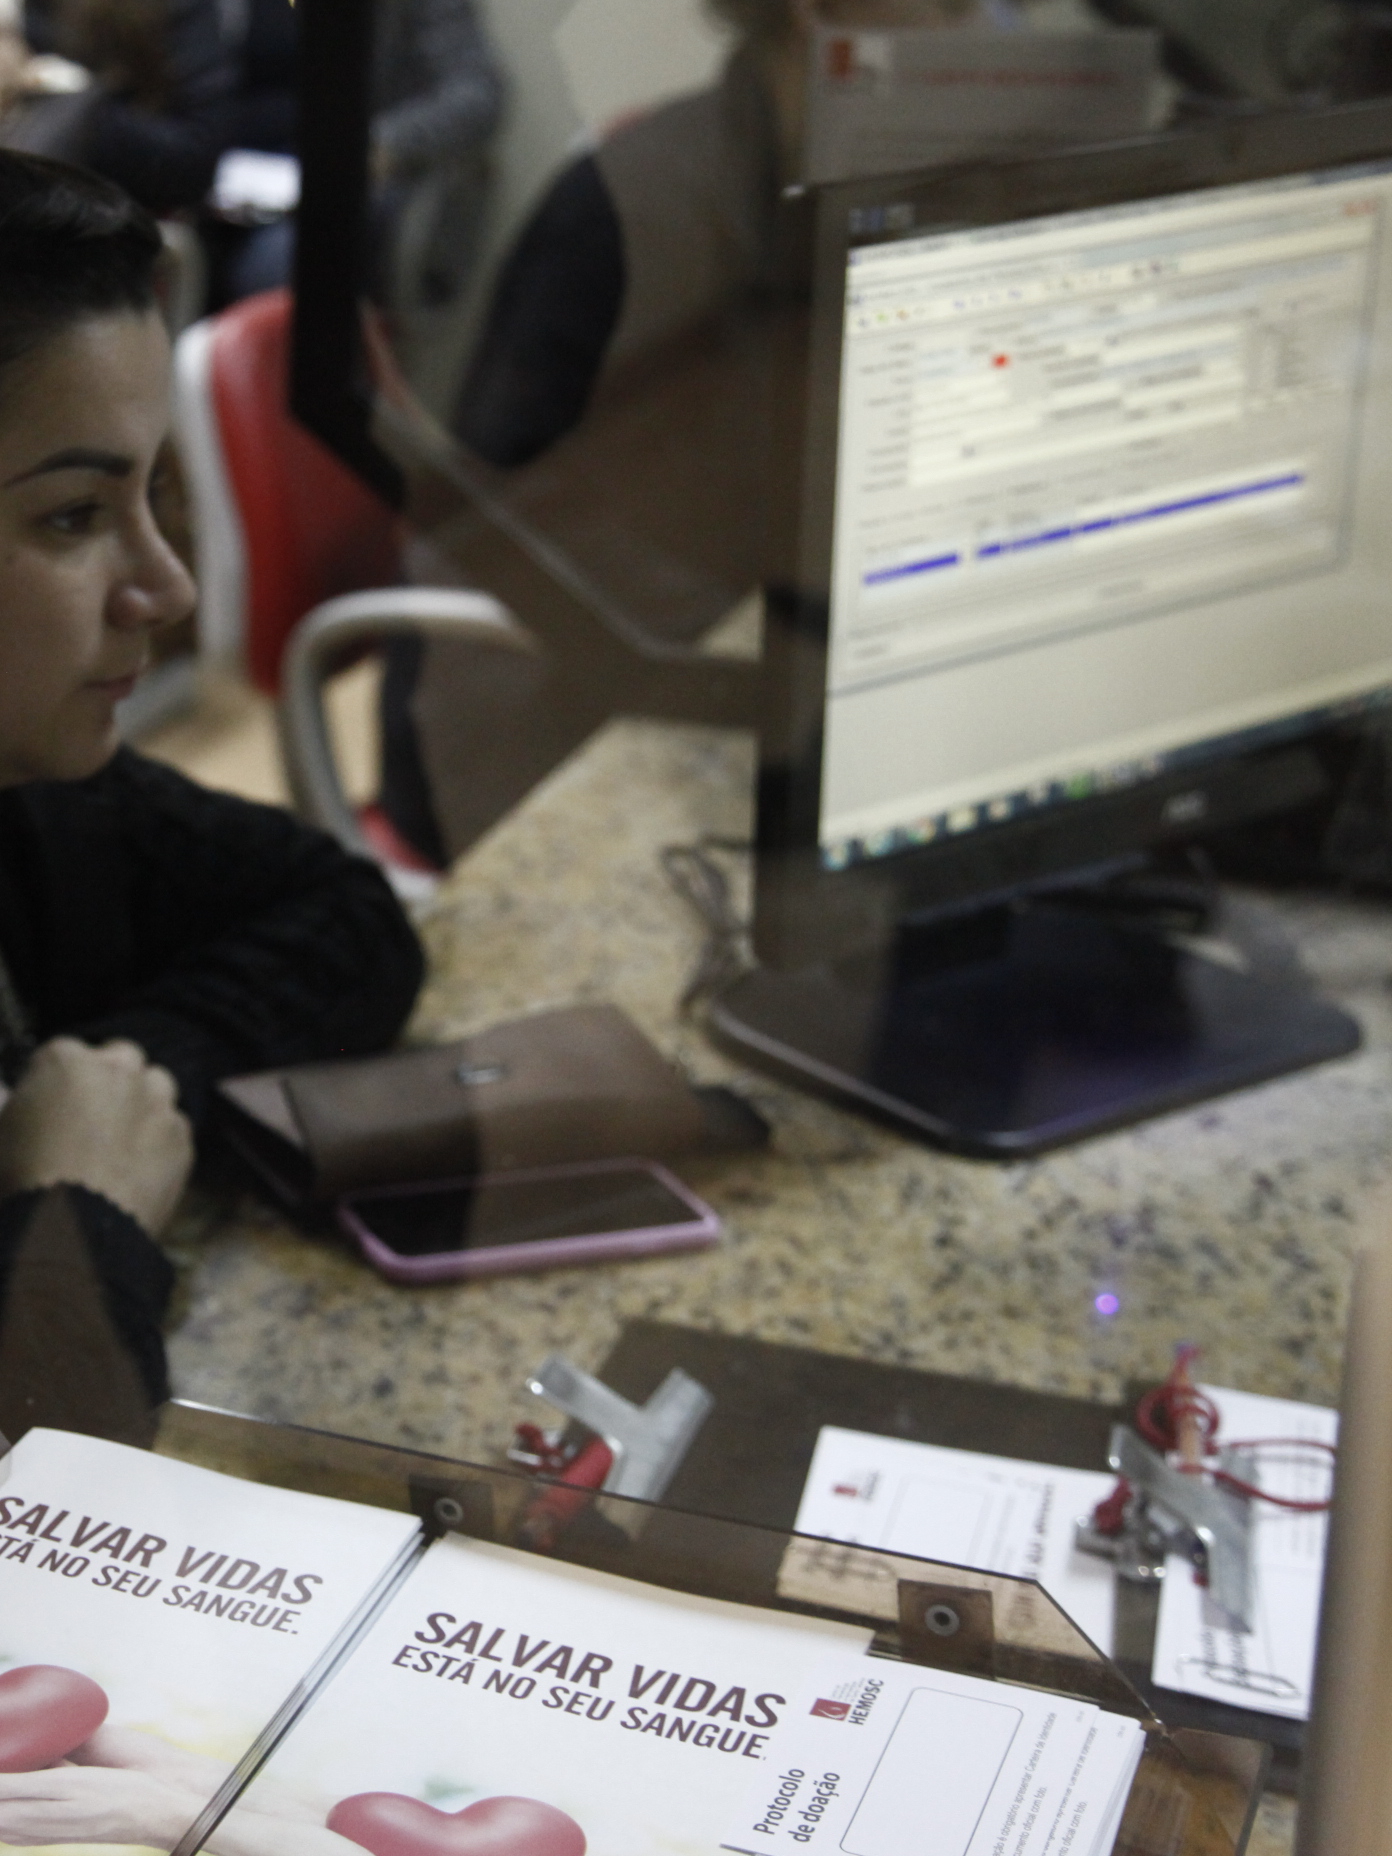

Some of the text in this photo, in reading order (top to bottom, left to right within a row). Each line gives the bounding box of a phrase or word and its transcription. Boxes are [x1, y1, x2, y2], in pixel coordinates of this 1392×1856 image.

[36, 1548, 91, 1578] NO
[91, 1565, 162, 1598] SEU
[162, 1584, 301, 1635] SANGUE.
[175, 1545, 324, 1605] VIDAS
[391, 1644, 476, 1685] ESTÁ
[481, 1668, 537, 1700] NO
[541, 1685, 616, 1721] SEU
[414, 1612, 787, 1729] SALVAR VIDAS
[848, 1679, 884, 1726] HEMOSC
[752, 1768, 805, 1835] Protocolo
[787, 1772, 841, 1843] de doação
[1014, 1772, 1033, 1804] apresentar
[1030, 1799, 1042, 1813] com
